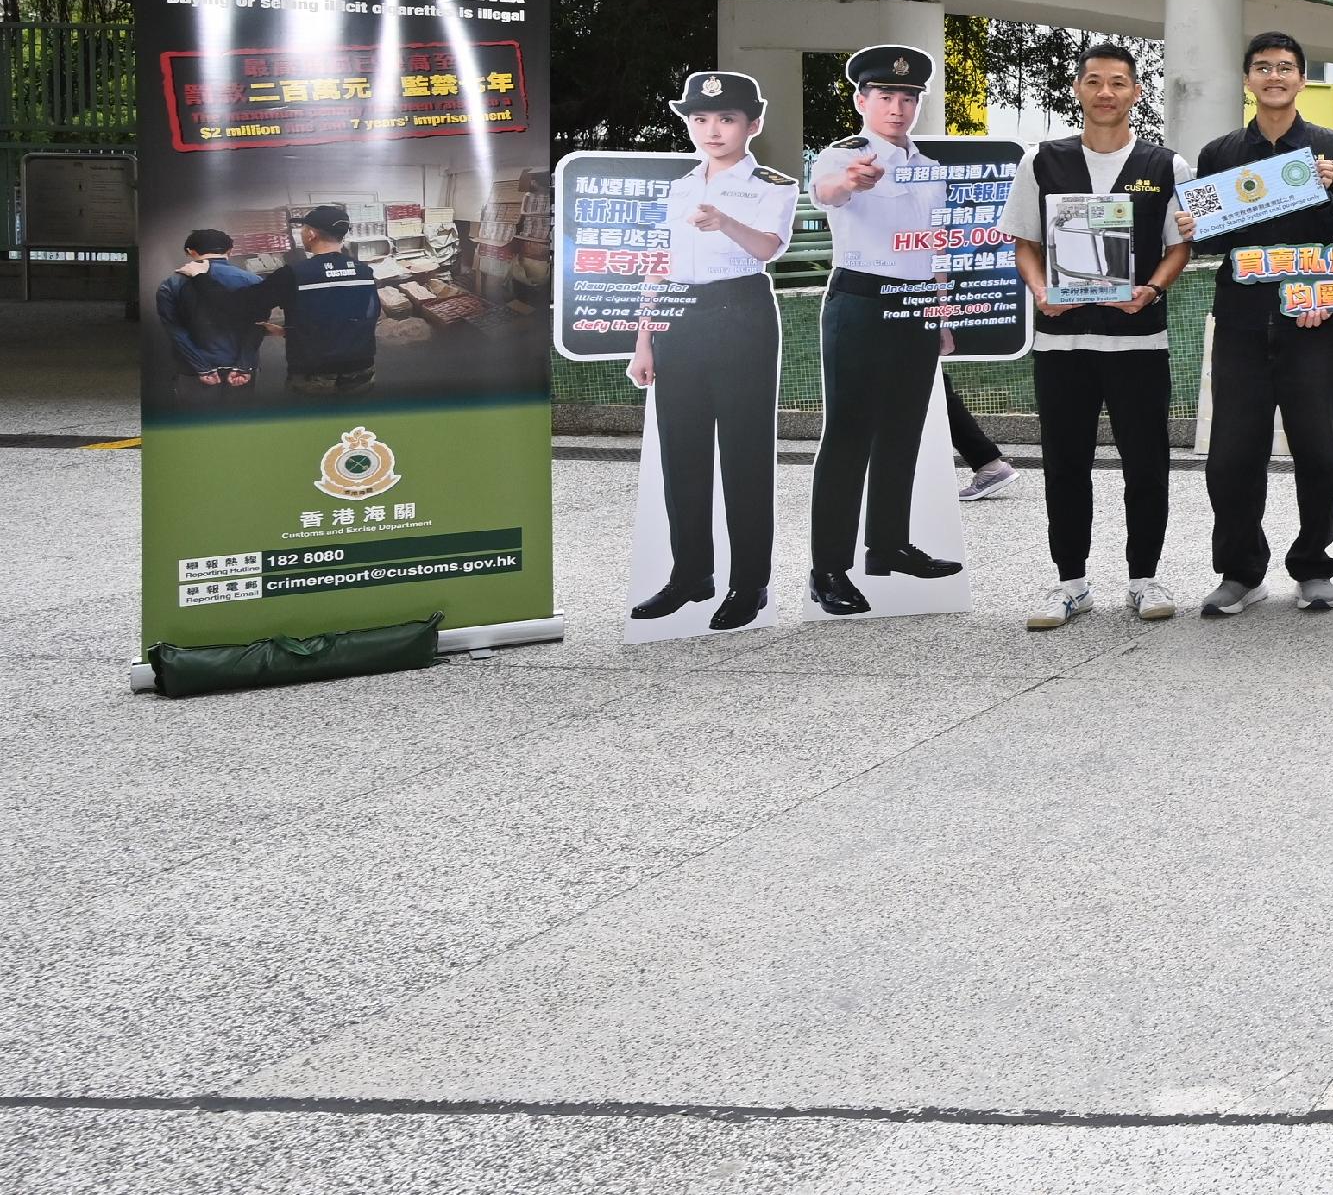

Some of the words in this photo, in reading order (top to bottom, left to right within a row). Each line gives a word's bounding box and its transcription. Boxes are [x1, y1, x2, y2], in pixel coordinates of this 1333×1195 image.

[459, 7, 473, 18] is
[478, 8, 525, 22] illegal
[200, 127, 222, 140] $2
[226, 125, 281, 137] million
[351, 118, 359, 129] 7
[367, 116, 408, 131] years'
[414, 110, 512, 127] imprisoment
[895, 164, 1017, 183] 帶超額煙酒入境
[575, 176, 671, 199] 私煙罪行
[1124, 184, 1161, 193] CUSTOMS
[574, 199, 669, 225] 新刑責
[575, 228, 671, 250] 違者必究
[893, 226, 1016, 252] HK$5,000
[574, 250, 671, 275] 要守法
[574, 281, 605, 292] New
[606, 281, 667, 294] penalties
[669, 281, 689, 293] for
[880, 280, 955, 294] Undeclared
[960, 277, 1017, 288] excessive
[940, 296, 952, 304] or
[955, 290, 1001, 302] tobacco
[574, 306, 597, 317] No
[602, 307, 630, 317] one
[634, 306, 685, 318] should
[884, 309, 911, 319] From
[994, 302, 1017, 312] fine
[573, 319, 609, 334] defy
[611, 319, 638, 332] the
[639, 320, 671, 333] law
[924, 320, 937, 330] to
[940, 315, 1017, 329] imprisonment
[300, 503, 416, 528] 香港海關
[282, 530, 324, 540] Customs
[327, 528, 343, 537] and
[346, 524, 377, 535] Excise
[379, 520, 432, 532] Department
[267, 554, 299, 568] 182
[303, 550, 344, 564] 8080
[186, 568, 228, 579] Reporting
[230, 565, 260, 574] Hotline
[267, 555, 517, 591] crimereport@customs.gov.hk
[186, 593, 231, 604] Reporting
[235, 590, 259, 599] Email
